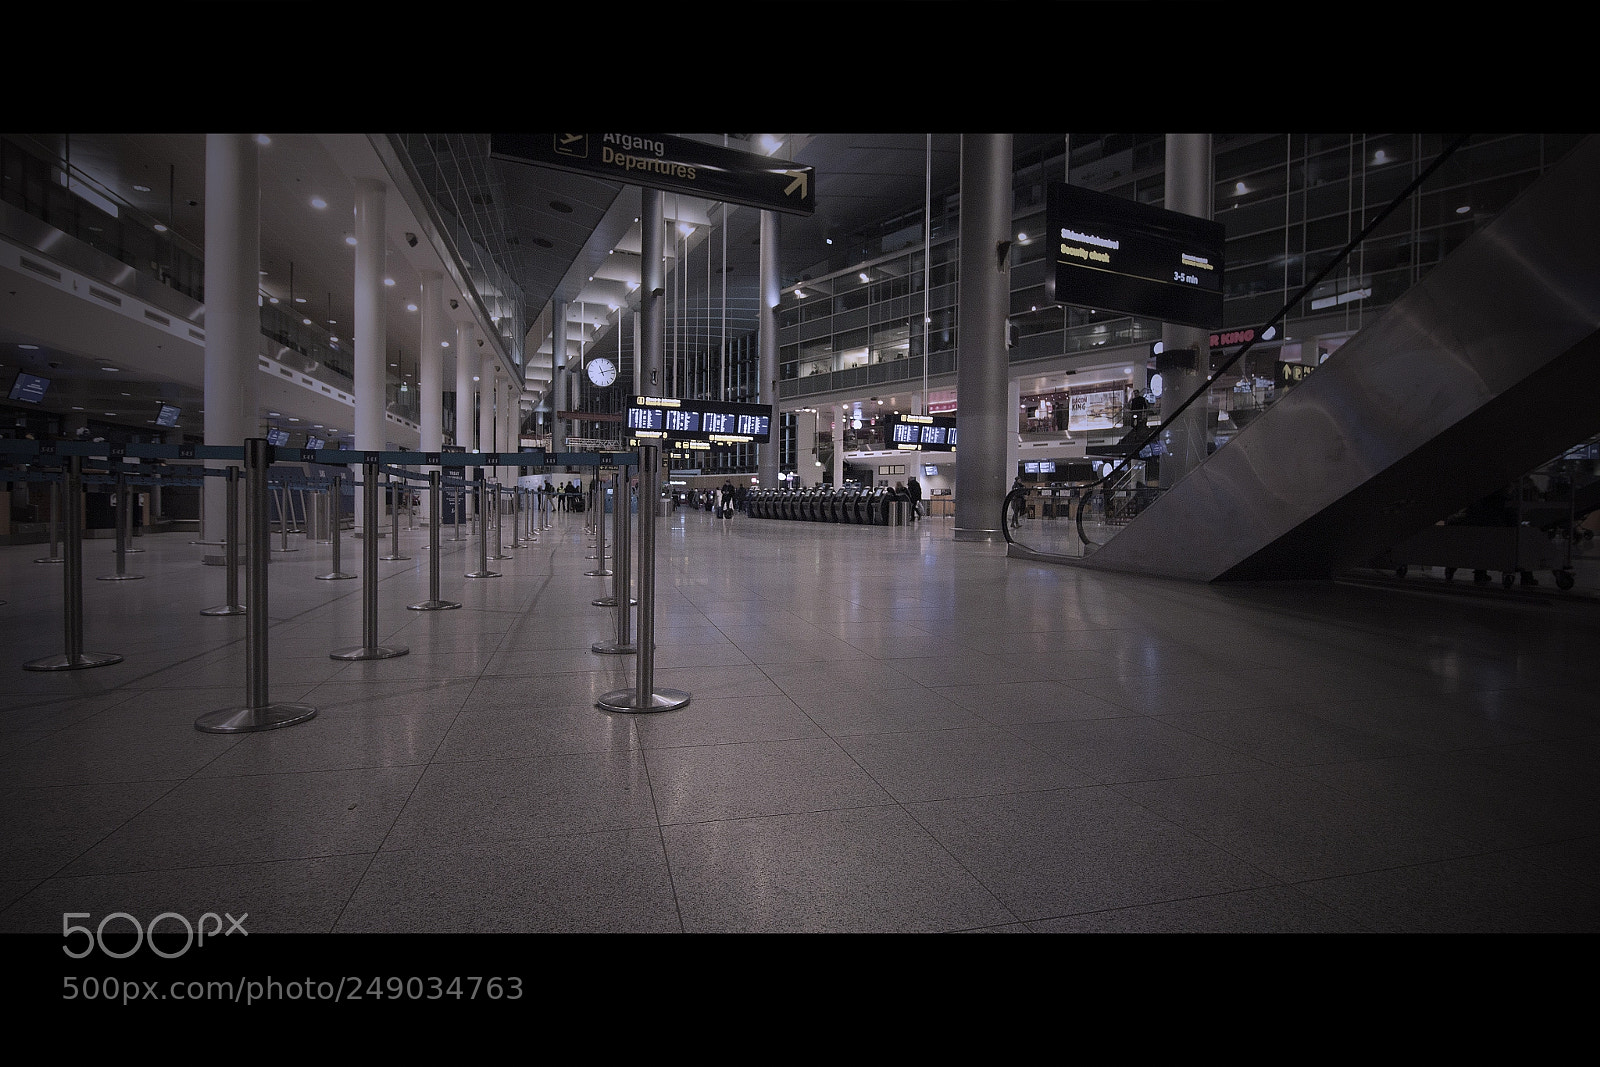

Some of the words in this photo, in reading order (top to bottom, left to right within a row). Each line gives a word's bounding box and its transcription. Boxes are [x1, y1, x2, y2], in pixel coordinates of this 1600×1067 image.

[602, 146, 696, 179] Departures
[1186, 274, 1199, 285] min
[1221, 329, 1255, 345] KING
[1071, 396, 1088, 404] BACON
[1071, 403, 1086, 411] KING
